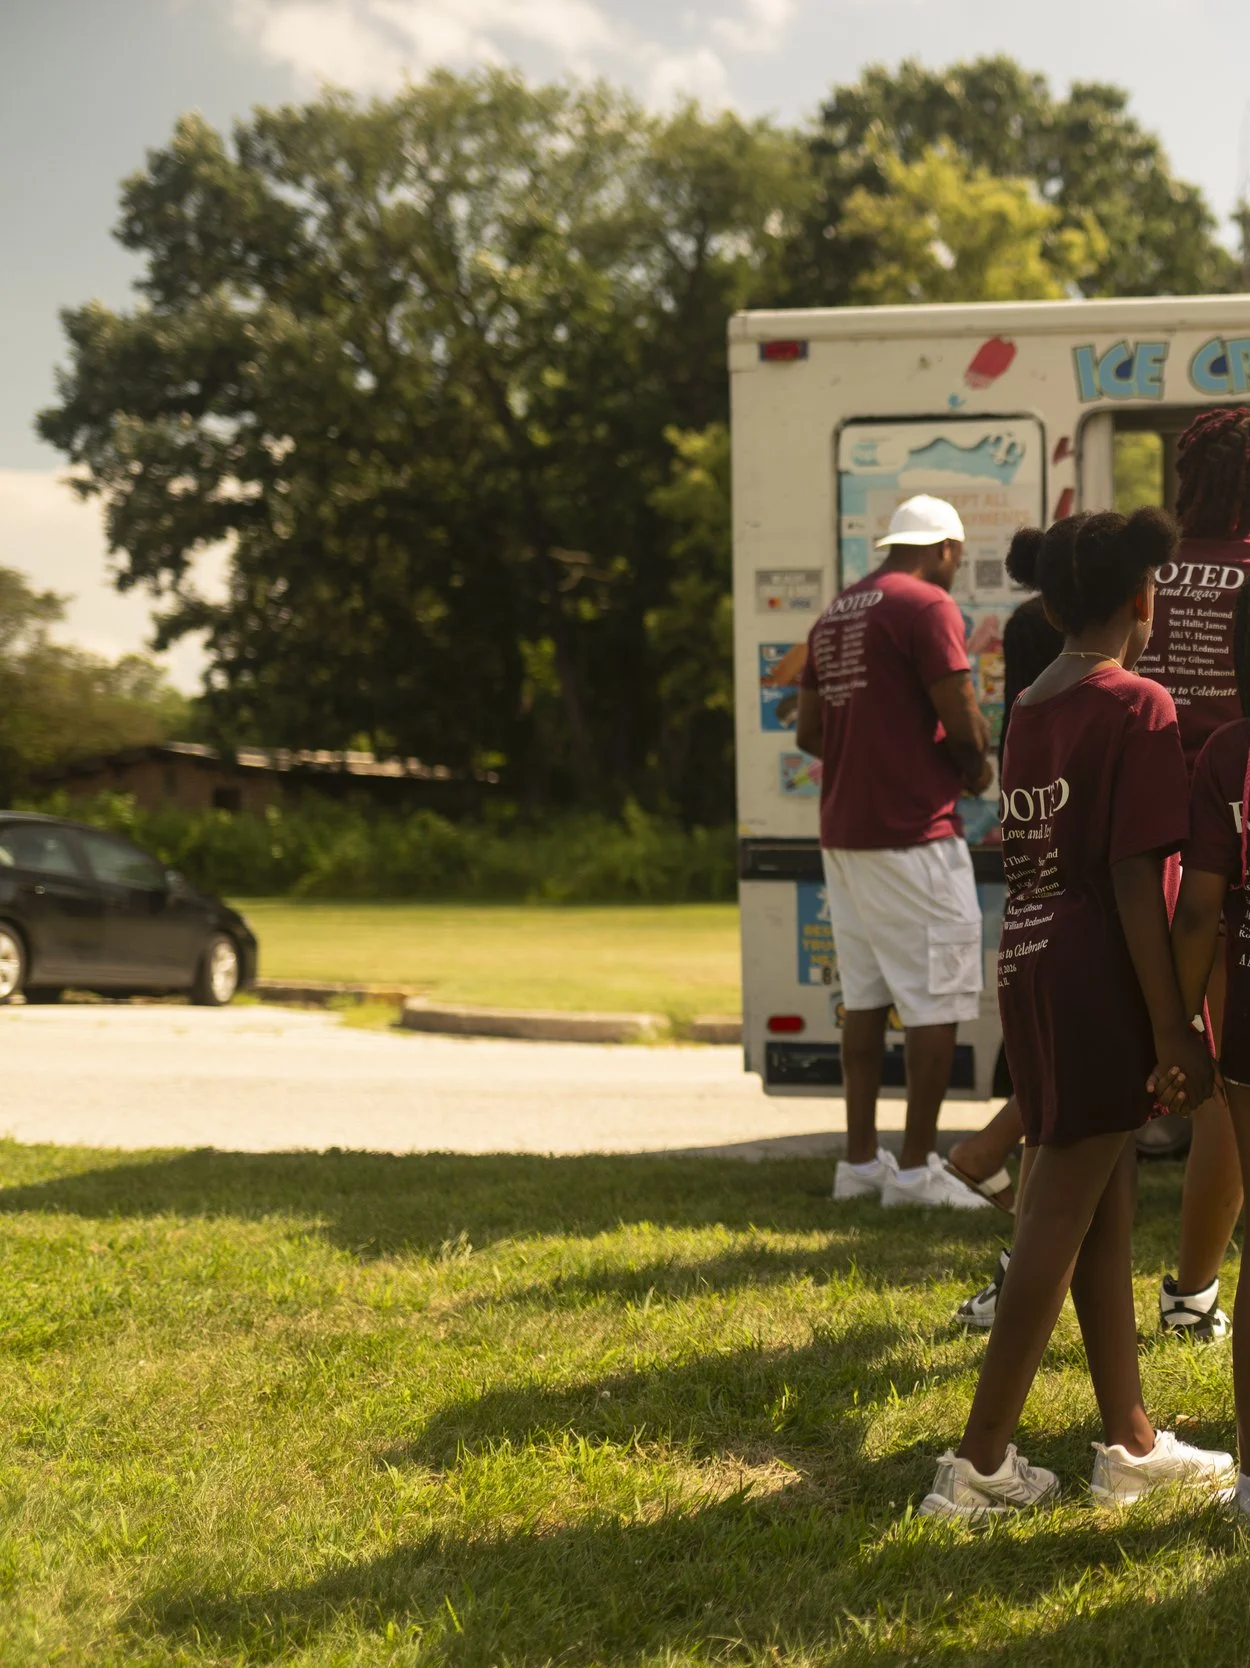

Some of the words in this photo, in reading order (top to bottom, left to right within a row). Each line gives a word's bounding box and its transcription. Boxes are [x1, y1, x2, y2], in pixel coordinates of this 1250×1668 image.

[1072, 338, 1169, 402] ICE
[1154, 562, 1245, 590] OTED
[1160, 586, 1183, 597] and
[1183, 586, 1221, 602] Legacy
[1170, 608, 1185, 616] Sam
[1187, 608, 1195, 616] H.
[1197, 609, 1233, 619] Redmond
[1182, 619, 1204, 629] Hallie
[1204, 621, 1227, 630] James
[1185, 631, 1193, 640] V.
[1195, 632, 1223, 642] Horton
[1168, 643, 1191, 652] Ariska
[1192, 644, 1229, 654] Redmond
[1168, 655, 1187, 665] Mary
[1189, 655, 1215, 665] Gibson
[1168, 666, 1195, 676] William
[1197, 668, 1235, 677] Redmond
[1178, 687, 1188, 695] to
[1190, 685, 1237, 697] Celebrate
[1027, 823, 1043, 840] and
[1035, 882, 1060, 894] orton
[1024, 912, 1055, 928] Redmond
[1006, 948, 1013, 959] to
[1014, 939, 1049, 957] Celebrate
[1239, 953, 1246, 966] A
[1003, 963, 1017, 974] 2026
